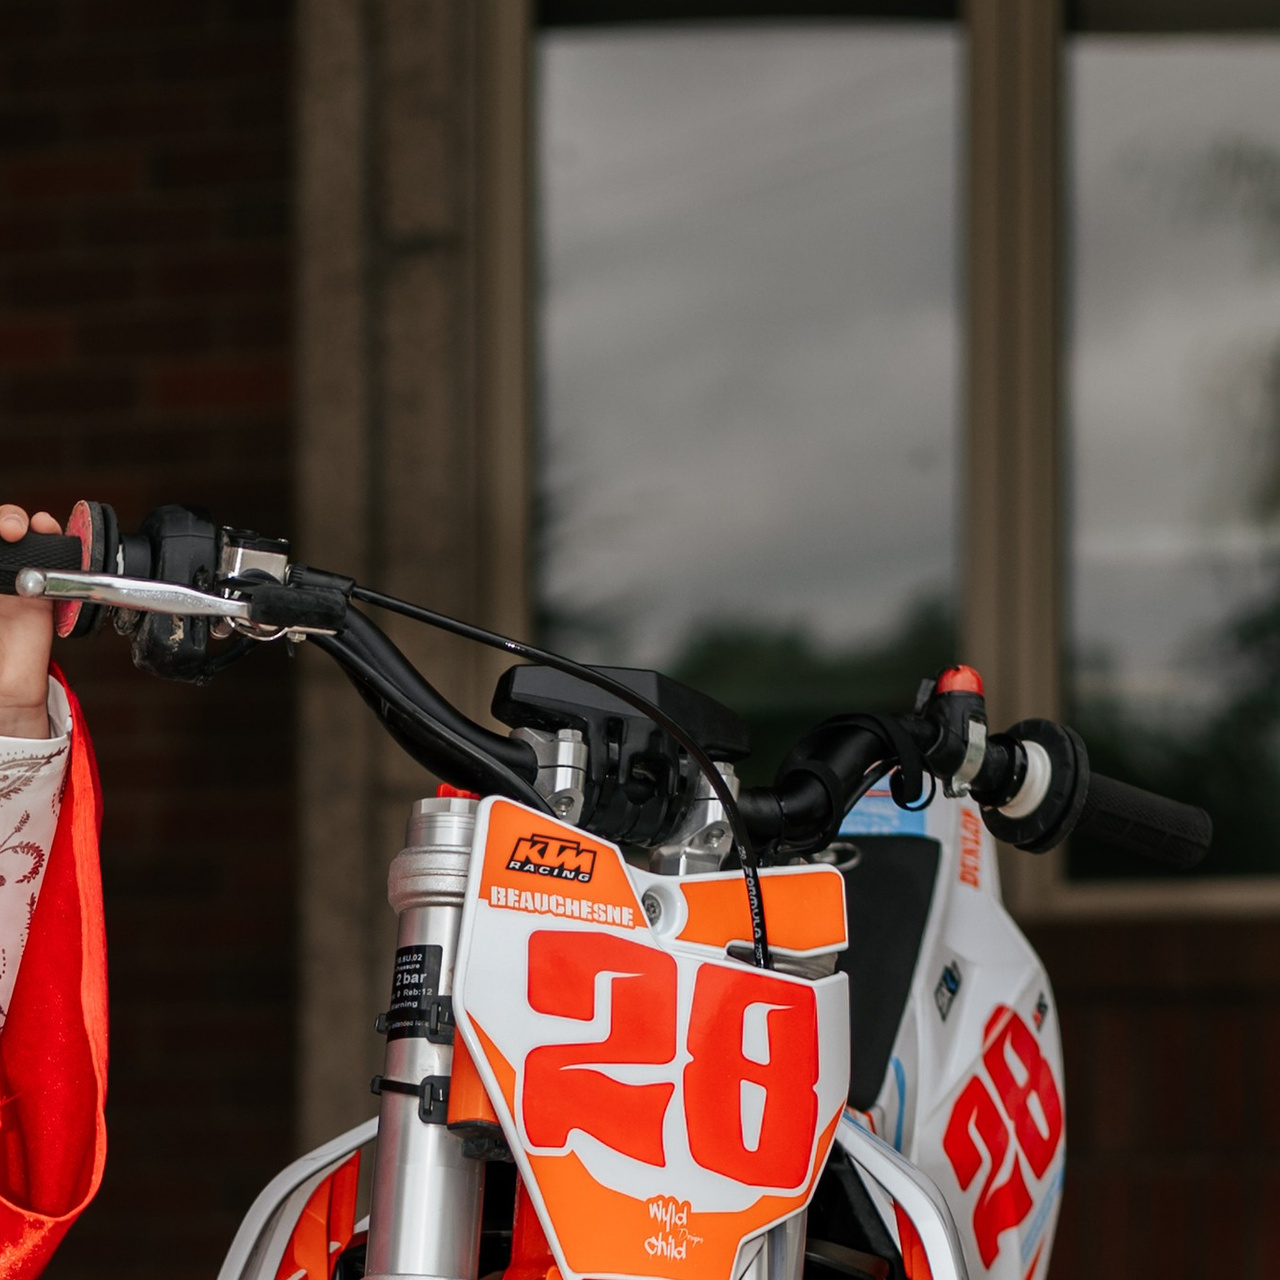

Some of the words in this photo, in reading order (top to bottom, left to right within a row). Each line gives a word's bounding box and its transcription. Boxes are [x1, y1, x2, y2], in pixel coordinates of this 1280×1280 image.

[508, 861, 591, 883] RACING
[512, 836, 596, 873] KTM
[490, 886, 634, 926] BEAUCHESNE
[743, 865, 762, 939] FORMULA
[403, 972, 428, 984] bar
[523, 930, 819, 1189] 28
[942, 1003, 1063, 1270] 28
